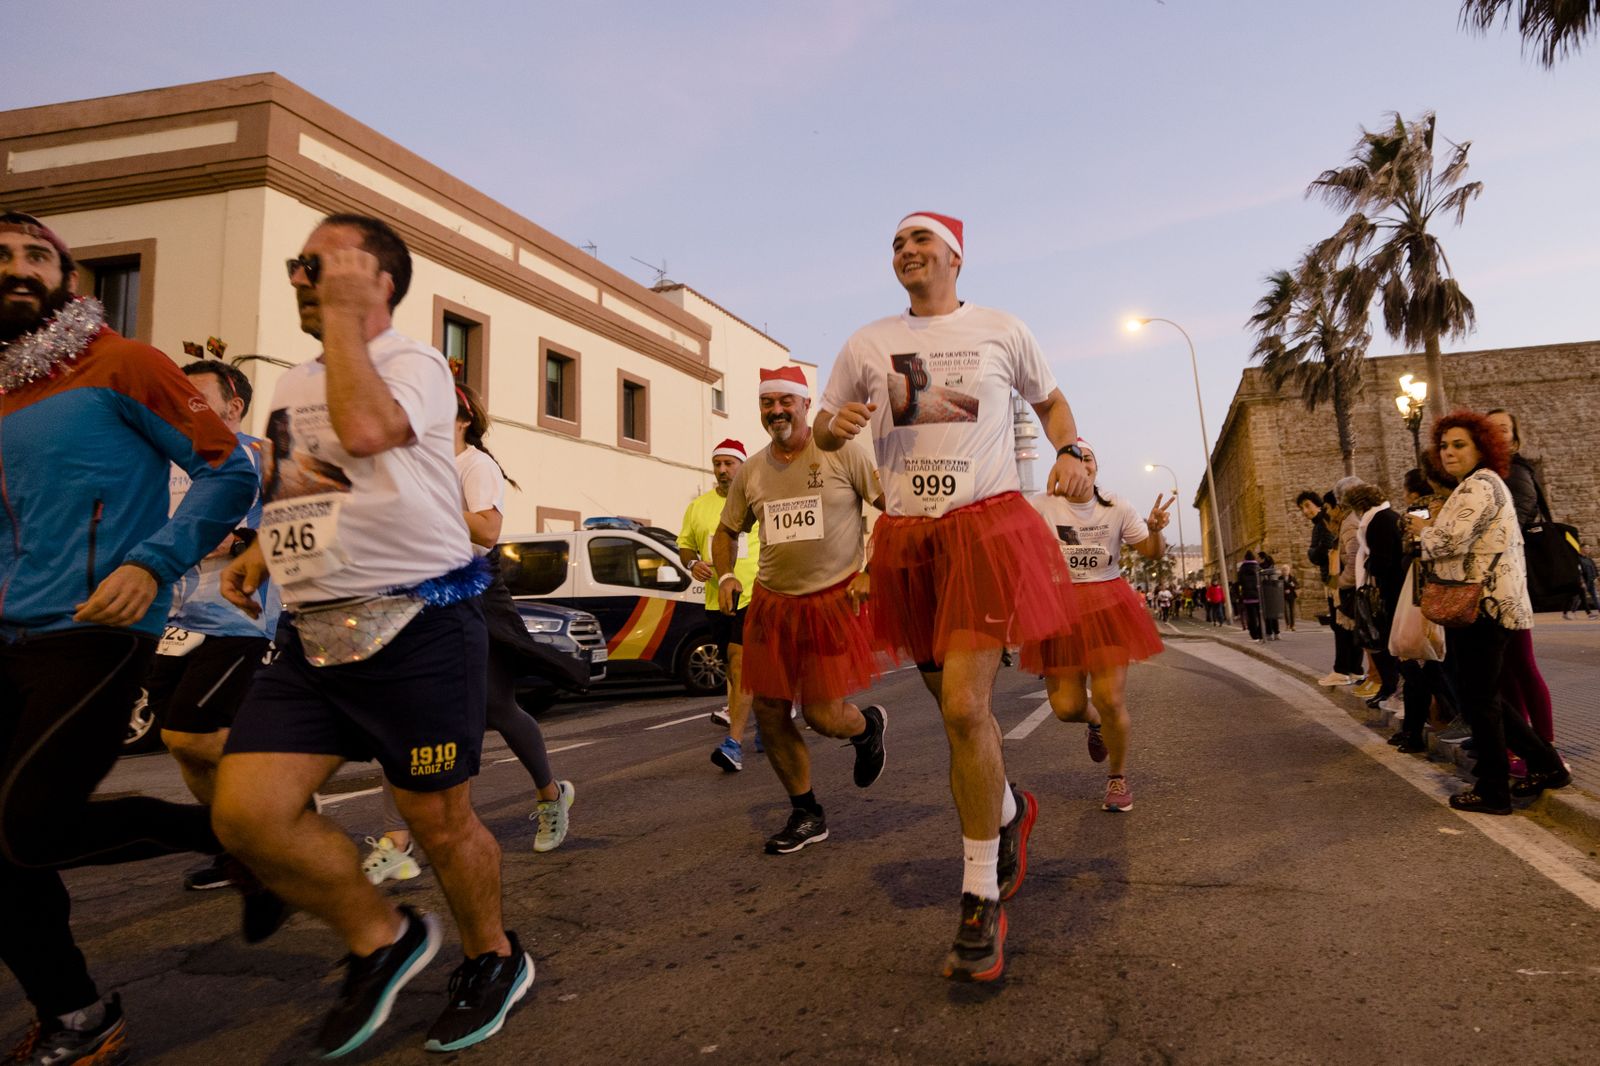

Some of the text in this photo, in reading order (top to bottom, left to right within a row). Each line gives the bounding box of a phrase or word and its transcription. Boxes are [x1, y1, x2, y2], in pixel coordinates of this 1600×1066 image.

[932, 464, 942, 472] DE
[912, 474, 956, 496] 999
[773, 509, 816, 530] 1046
[269, 523, 316, 556] 246
[1069, 555, 1098, 569] 946
[410, 742, 457, 766] 1910
[410, 760, 456, 776] CADIZ CF
